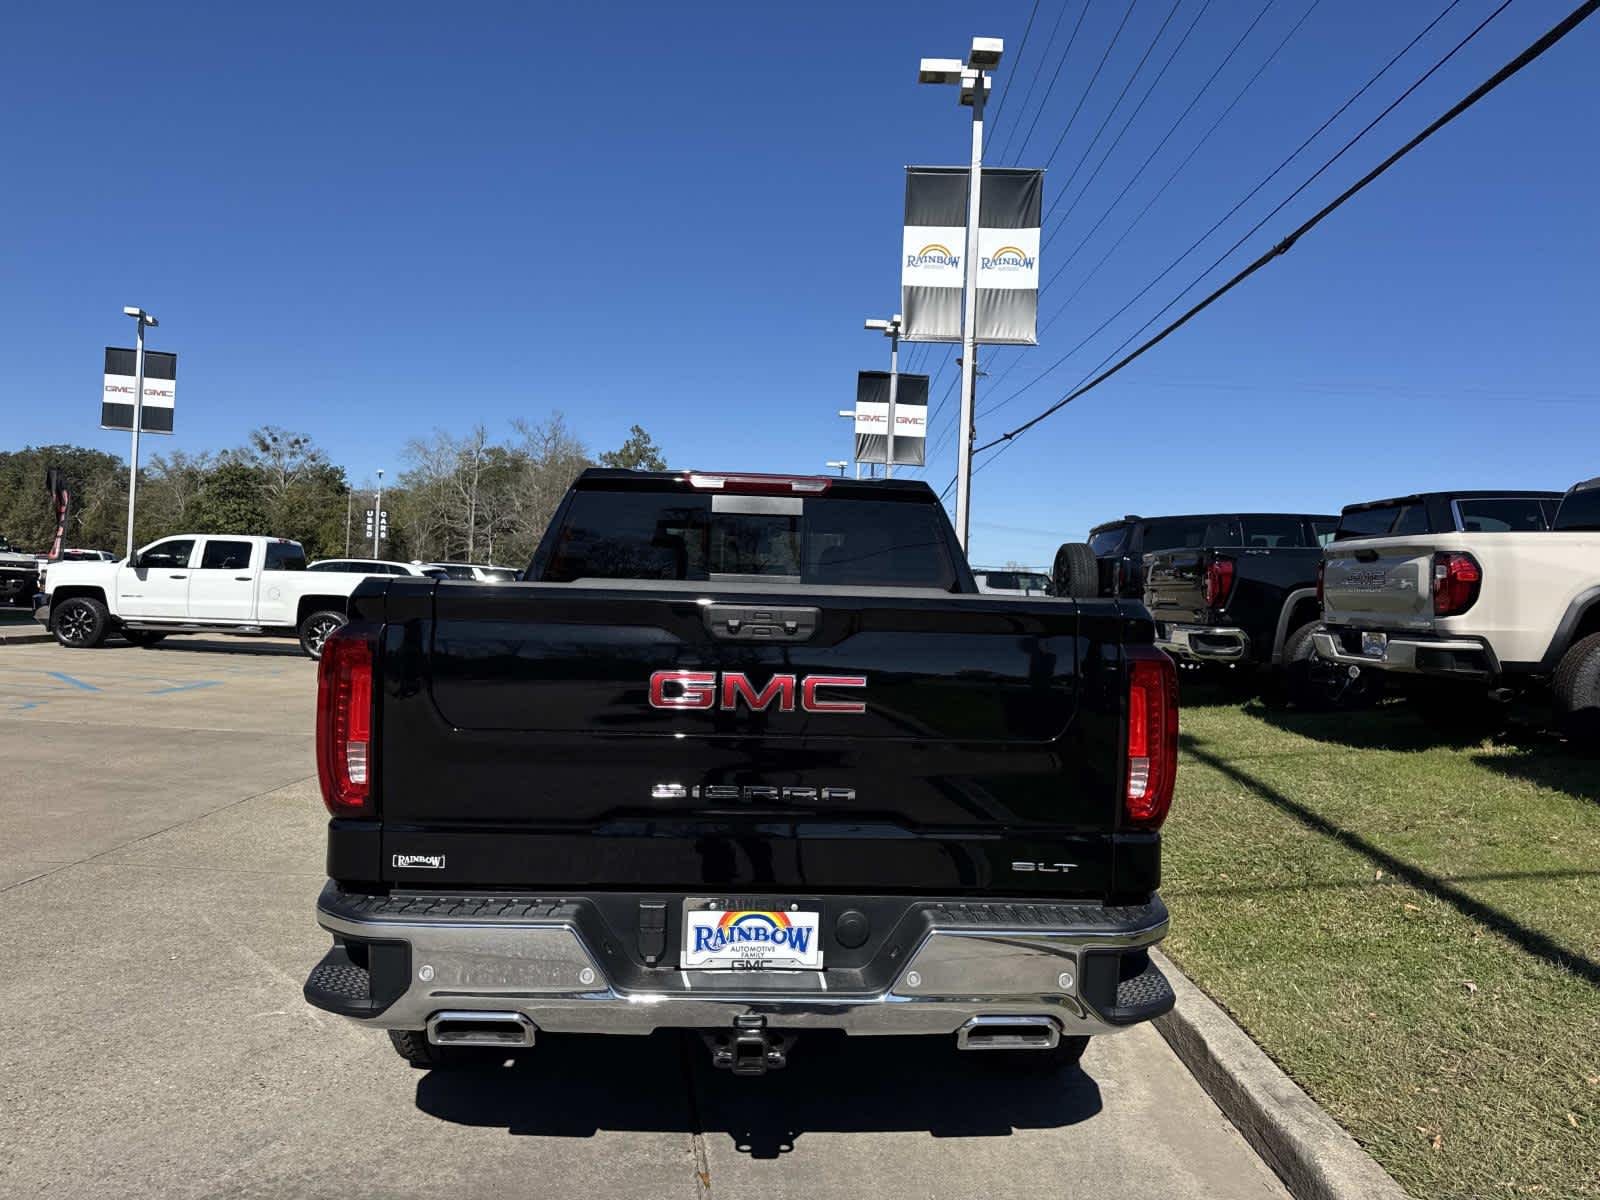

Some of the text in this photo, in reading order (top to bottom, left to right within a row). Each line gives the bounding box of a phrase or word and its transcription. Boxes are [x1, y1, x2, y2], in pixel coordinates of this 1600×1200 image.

[906, 255, 960, 268] RAINBOW
[981, 256, 1035, 270] RAINBOW
[105, 385, 135, 394] GMC
[143, 388, 174, 398] GMC
[857, 414, 888, 423] GMC
[896, 416, 925, 425] GMC
[648, 670, 867, 713] GMC
[651, 784, 856, 801] SIERRA
[398, 855, 441, 868] RAINBOW
[1011, 862, 1079, 873] SLT
[694, 926, 814, 953] RAINBOW
[730, 945, 776, 953] AUTOMOTIVE
[731, 959, 774, 968] GMC
